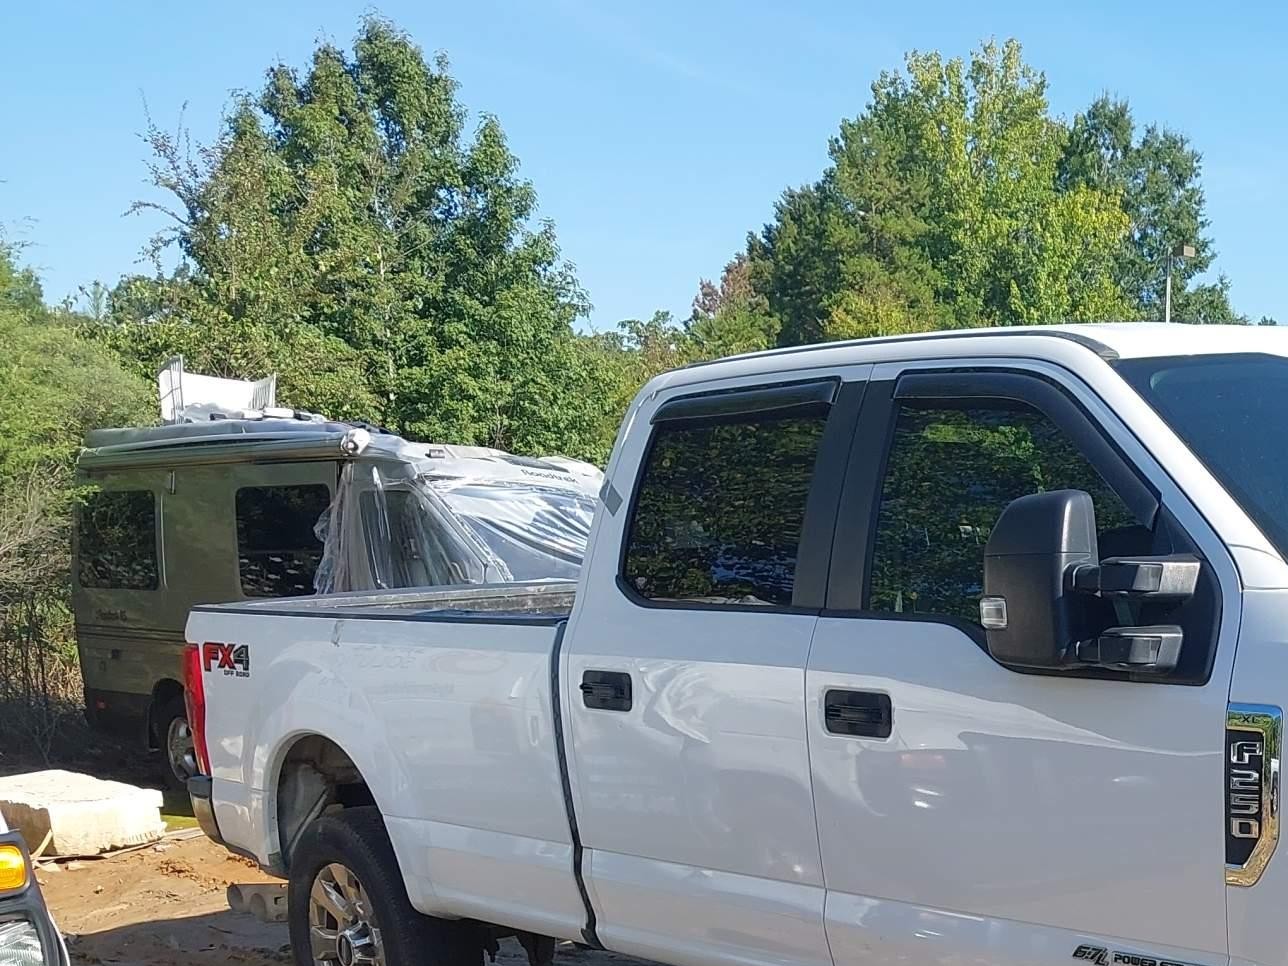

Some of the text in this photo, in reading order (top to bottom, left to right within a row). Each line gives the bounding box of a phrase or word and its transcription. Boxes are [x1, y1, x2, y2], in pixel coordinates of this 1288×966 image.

[203, 641, 250, 672] FX4
[1231, 741, 1262, 838] F250
[1073, 944, 1109, 966] 6.7L
